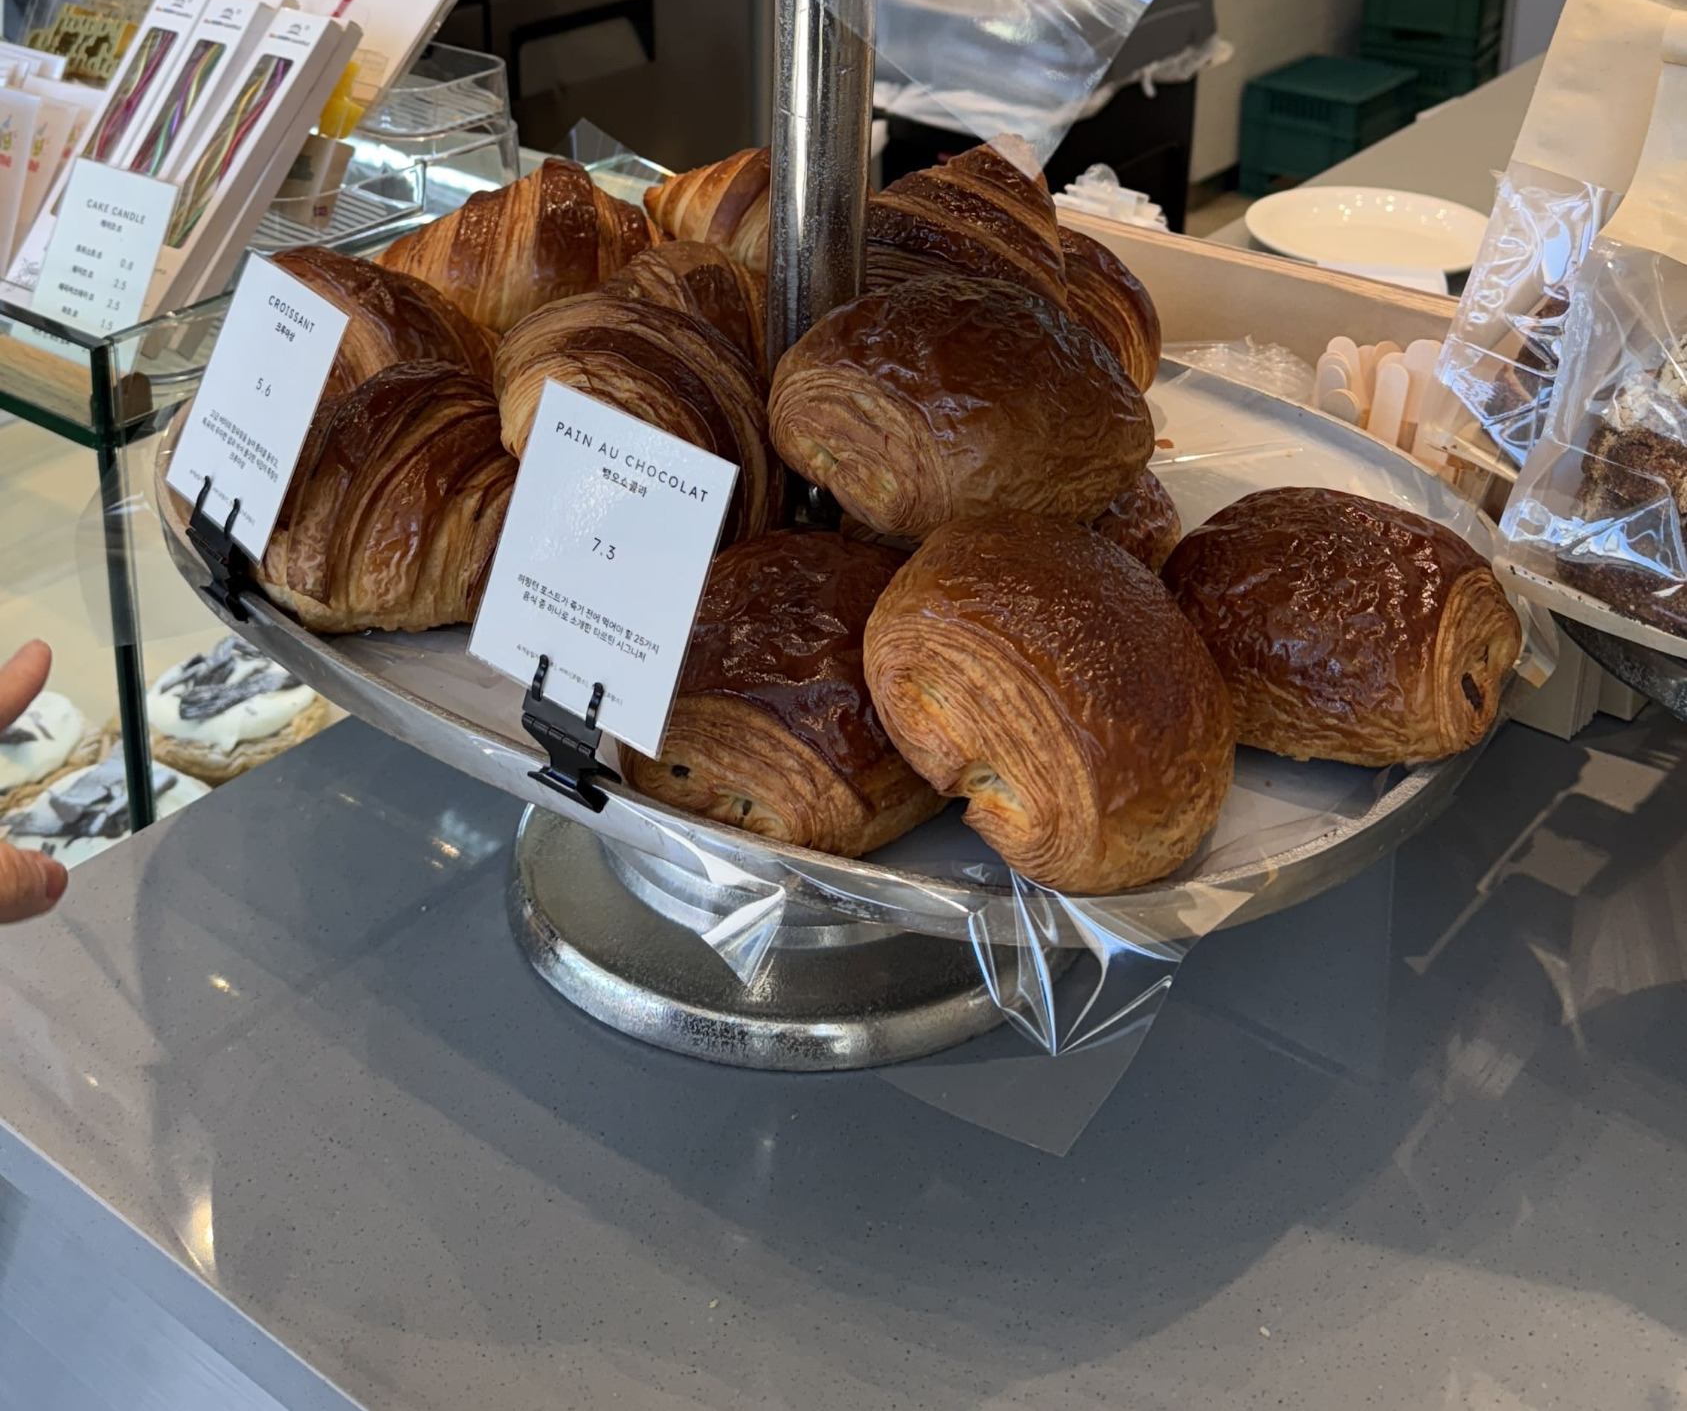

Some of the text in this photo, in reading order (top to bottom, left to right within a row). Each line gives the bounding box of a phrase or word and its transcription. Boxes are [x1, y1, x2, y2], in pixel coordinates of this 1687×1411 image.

[86, 198, 146, 225] CAKE CANDLE
[113, 279, 127, 291] 2.5
[107, 299, 121, 311] 2.5
[268, 295, 315, 333] CROISSANT
[101, 319, 113, 331] 1.5
[255, 378, 271, 397] 5.6
[555, 421, 708, 503] PAIN AU CHOCOLAT
[592, 537, 616, 560] 7.3
[517, 573, 660, 655] 허핑턴 포스트가 죽기 전에 먹어야 할 25가지
[522, 590, 538, 605] 음식
[547, 604, 568, 622] 하나로
[569, 616, 592, 634] 소개한
[593, 628, 615, 646] 타르틴
[616, 641, 647, 662] 시그니처
